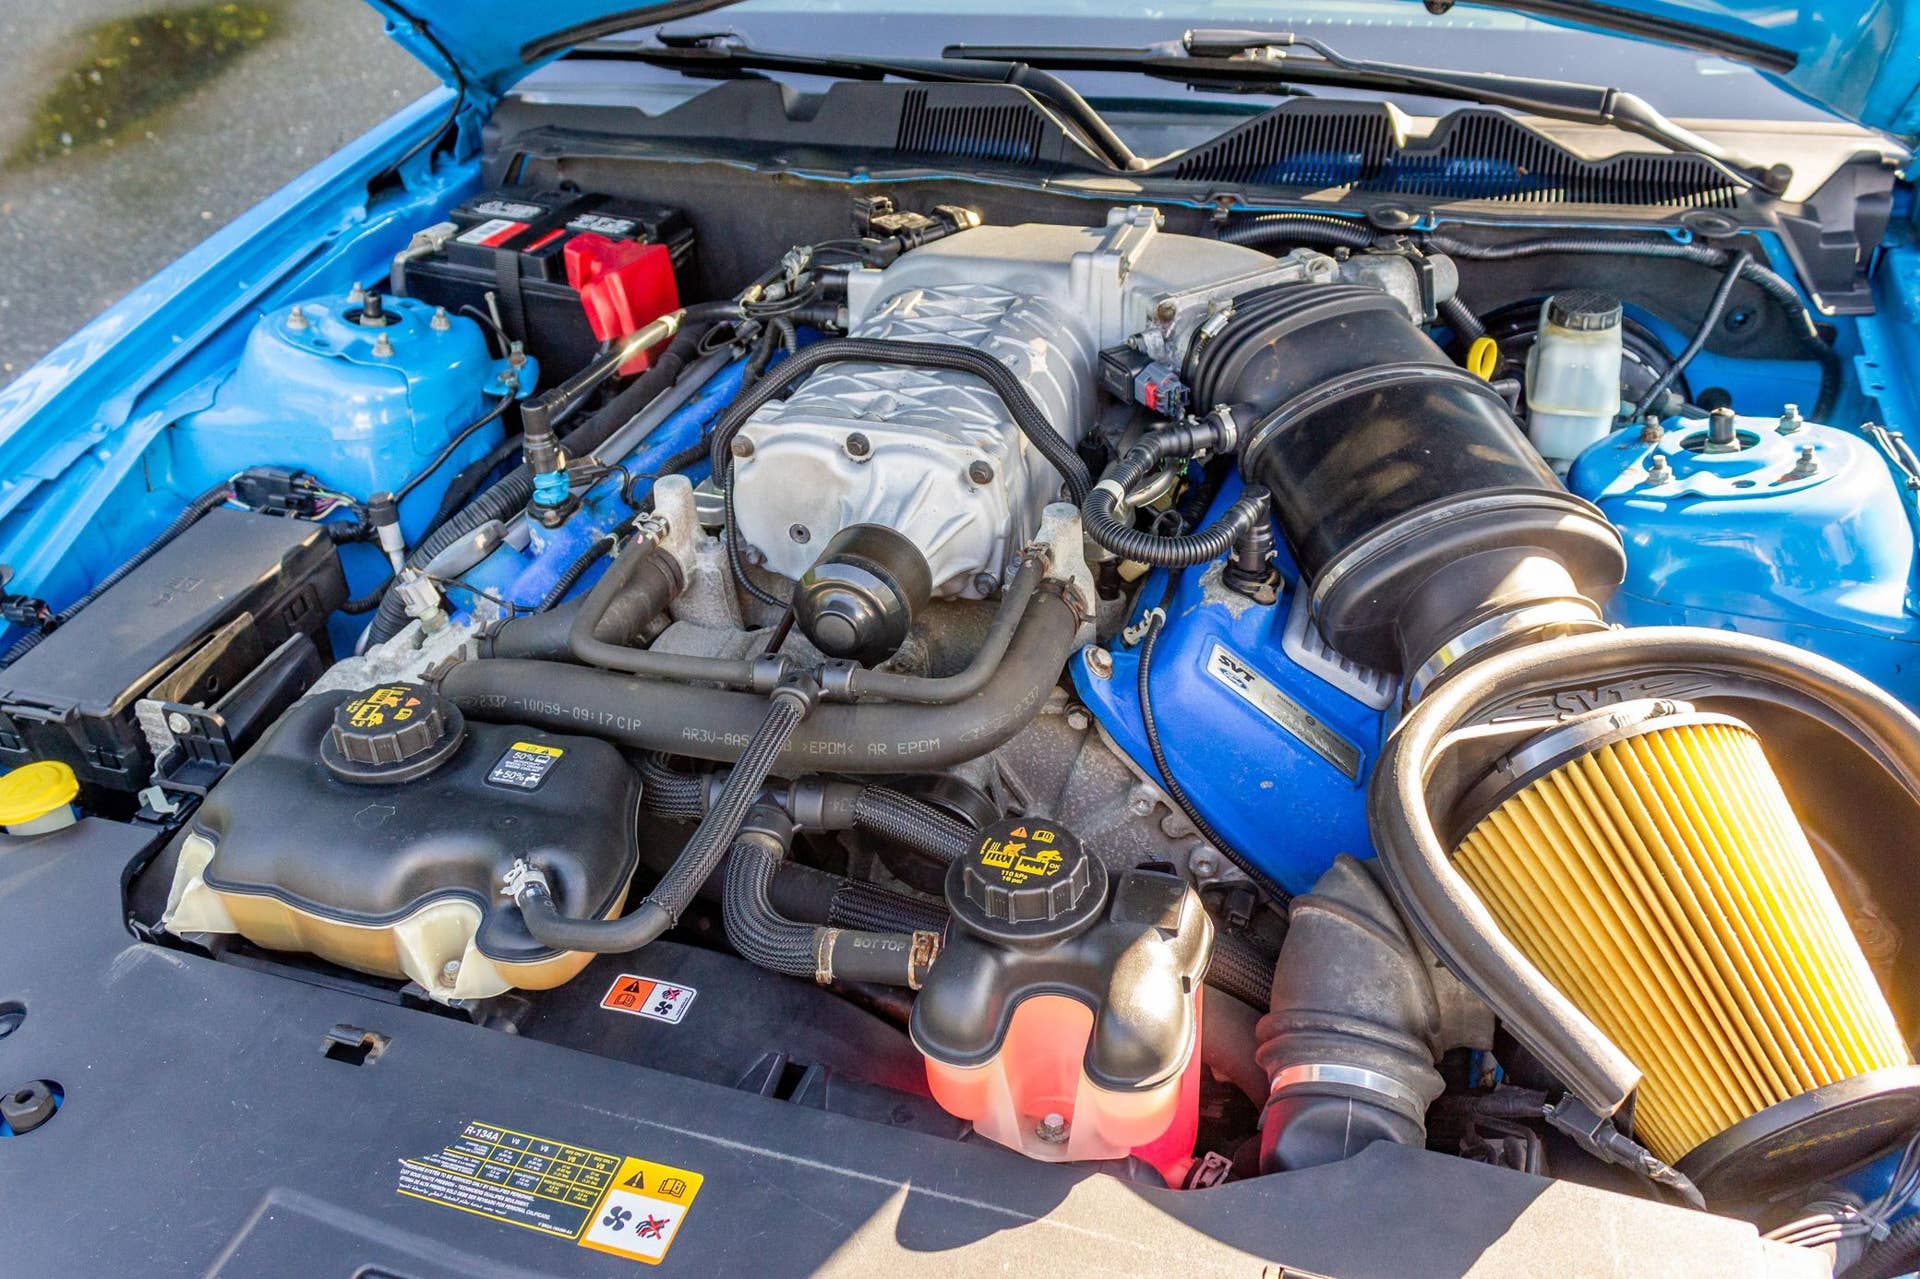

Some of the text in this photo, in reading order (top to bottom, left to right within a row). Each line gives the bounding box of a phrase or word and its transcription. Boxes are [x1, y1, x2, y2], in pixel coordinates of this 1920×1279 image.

[1218, 654, 1256, 683] SVT
[868, 743, 888, 756] AR
[897, 738, 940, 756] EPDM
[512, 751, 535, 762] 50%
[1001, 869, 1014, 877] 110
[464, 1125, 500, 1142] R-134A
